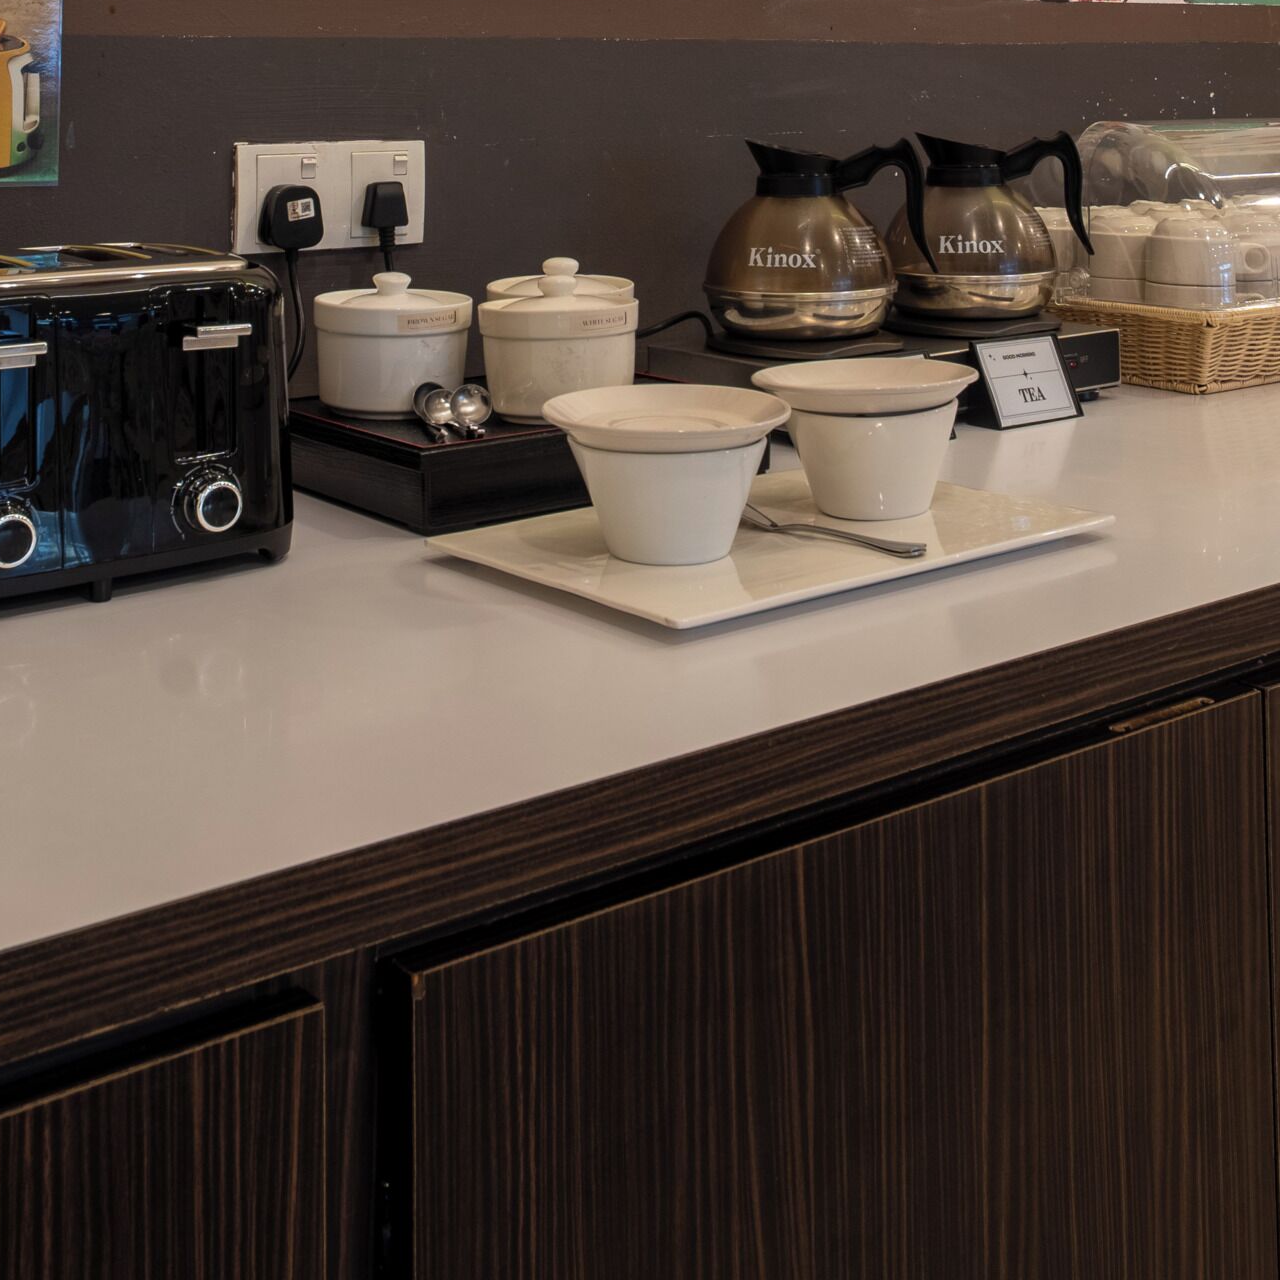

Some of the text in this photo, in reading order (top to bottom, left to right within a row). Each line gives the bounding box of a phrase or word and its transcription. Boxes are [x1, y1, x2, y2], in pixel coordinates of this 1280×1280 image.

[937, 234, 1006, 254] Kinox
[748, 246, 817, 269] Kinox
[1018, 386, 1047, 403] TEA
